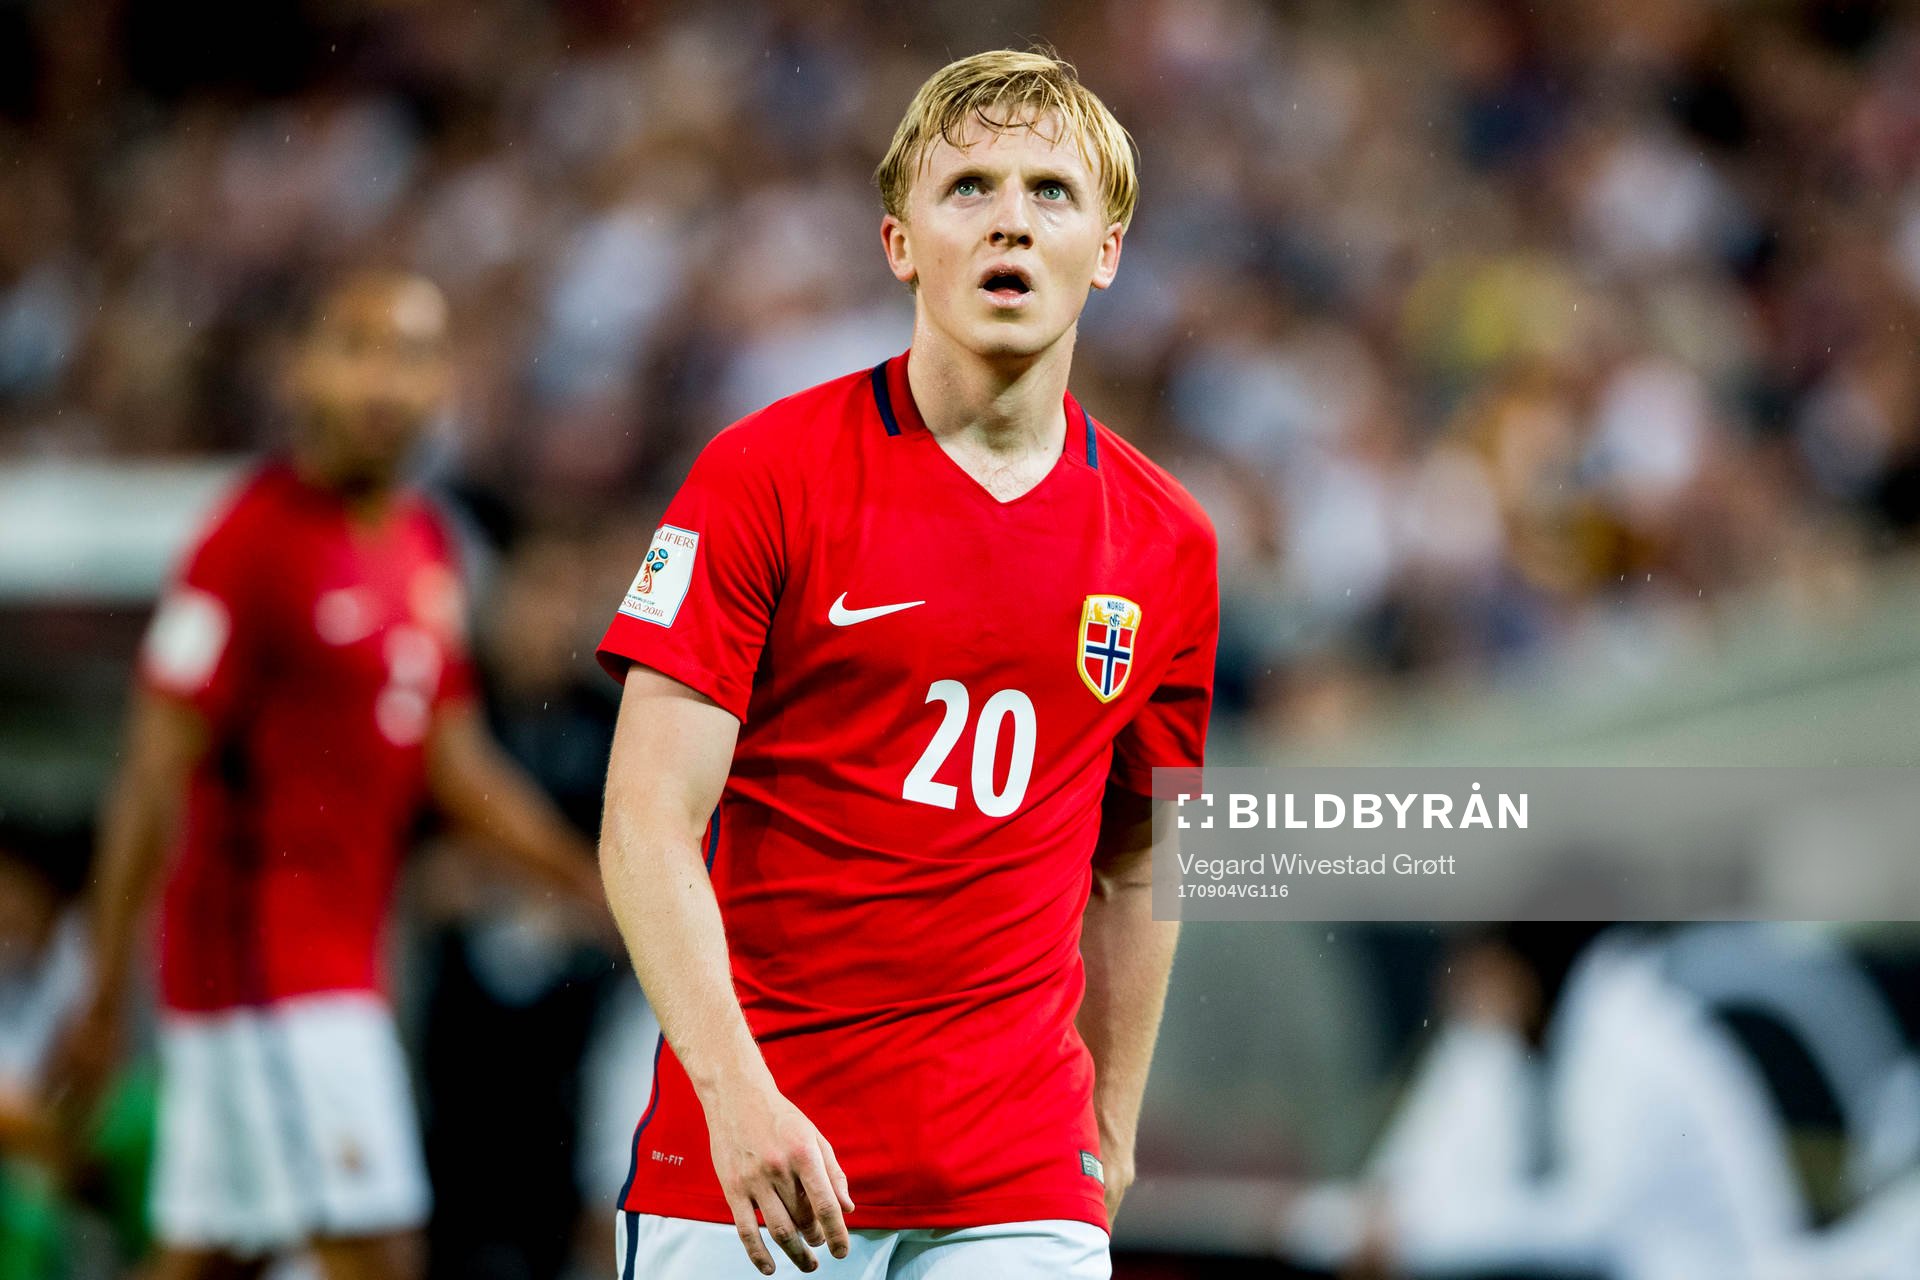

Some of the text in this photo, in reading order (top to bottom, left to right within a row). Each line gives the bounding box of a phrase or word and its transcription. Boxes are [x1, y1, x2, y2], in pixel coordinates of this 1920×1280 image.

[643, 605, 663, 617] 2018
[1107, 600, 1125, 612] NORGE
[902, 679, 1037, 818] 20
[651, 1150, 684, 1166] DRI-FIT
